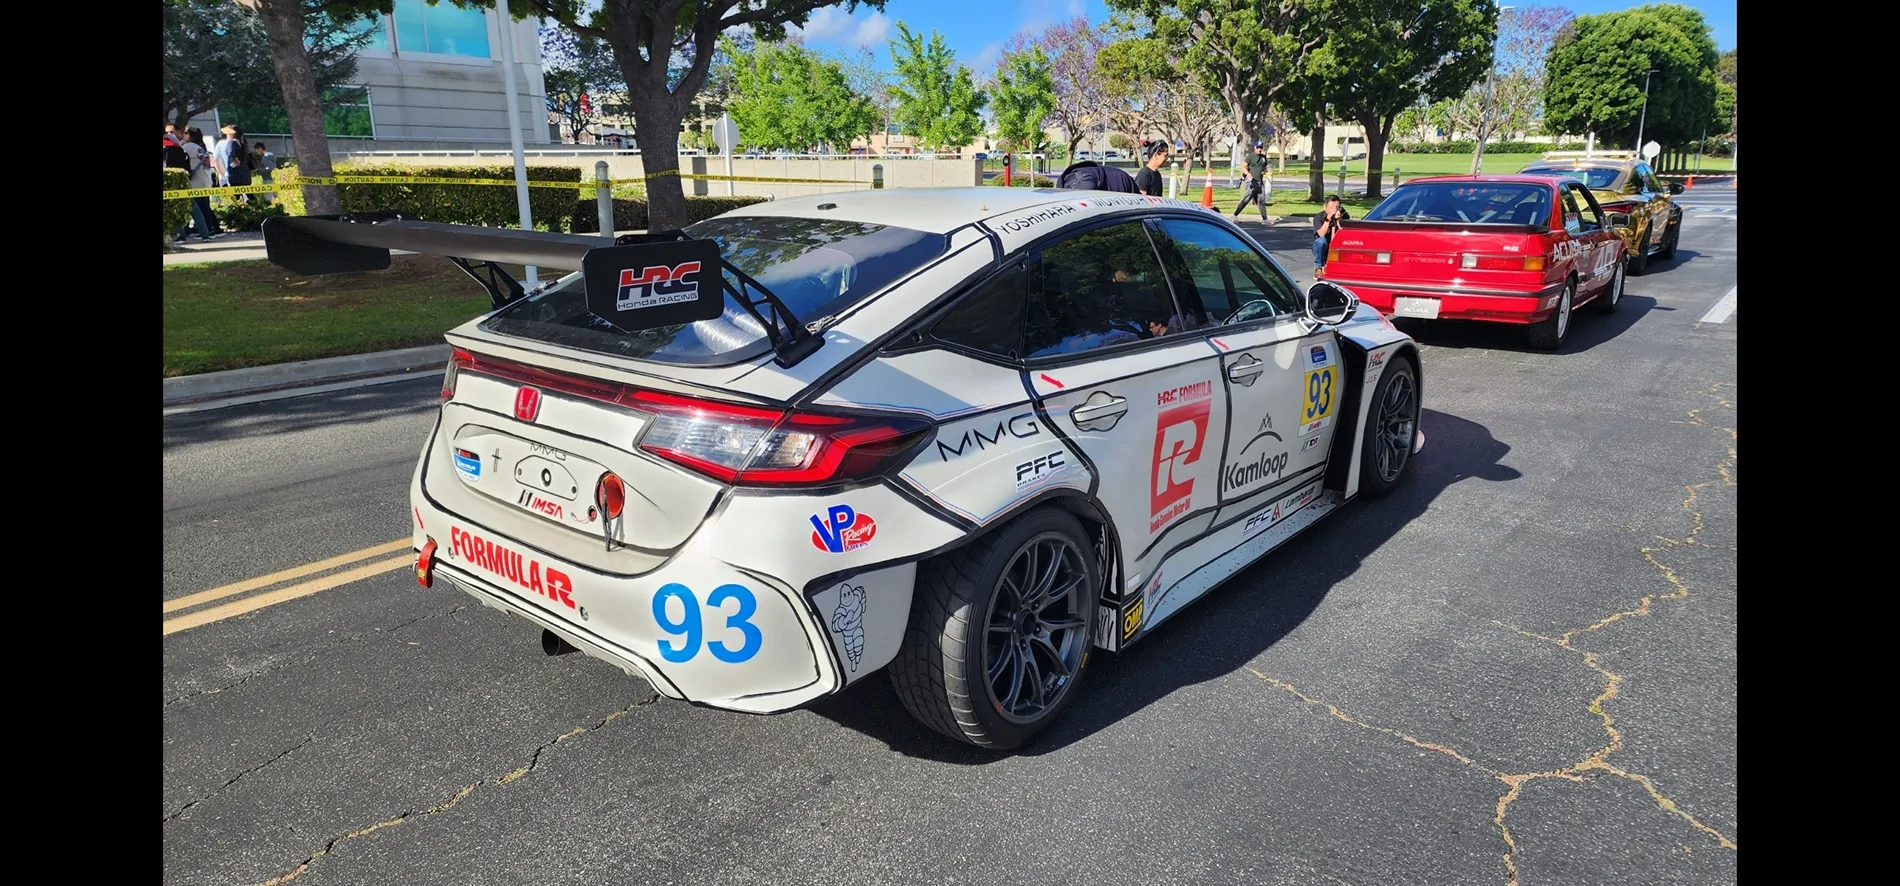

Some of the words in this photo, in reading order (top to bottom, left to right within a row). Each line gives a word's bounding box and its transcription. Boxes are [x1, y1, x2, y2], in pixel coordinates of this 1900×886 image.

[995, 205, 1076, 234] YOSHIHARA
[1552, 239, 1582, 262] ACURA
[619, 261, 701, 301] HRC
[618, 299, 657, 310] Honda
[659, 292, 698, 303] RACING
[1158, 388, 1178, 406] HRC
[1179, 380, 1212, 402] FORMULA
[1307, 370, 1331, 418] 93
[530, 442, 567, 462] MMG
[936, 412, 1040, 462] MMG
[1016, 451, 1065, 482] PFC
[1224, 452, 1288, 492] Kamloop
[531, 497, 563, 519] IMSA
[1244, 508, 1272, 530] PFC
[809, 504, 855, 553] VP
[844, 522, 876, 545] Racing
[451, 526, 544, 595] FORMULA
[546, 567, 575, 609] R
[652, 583, 763, 664] 93
[1124, 603, 1142, 633] OMP
